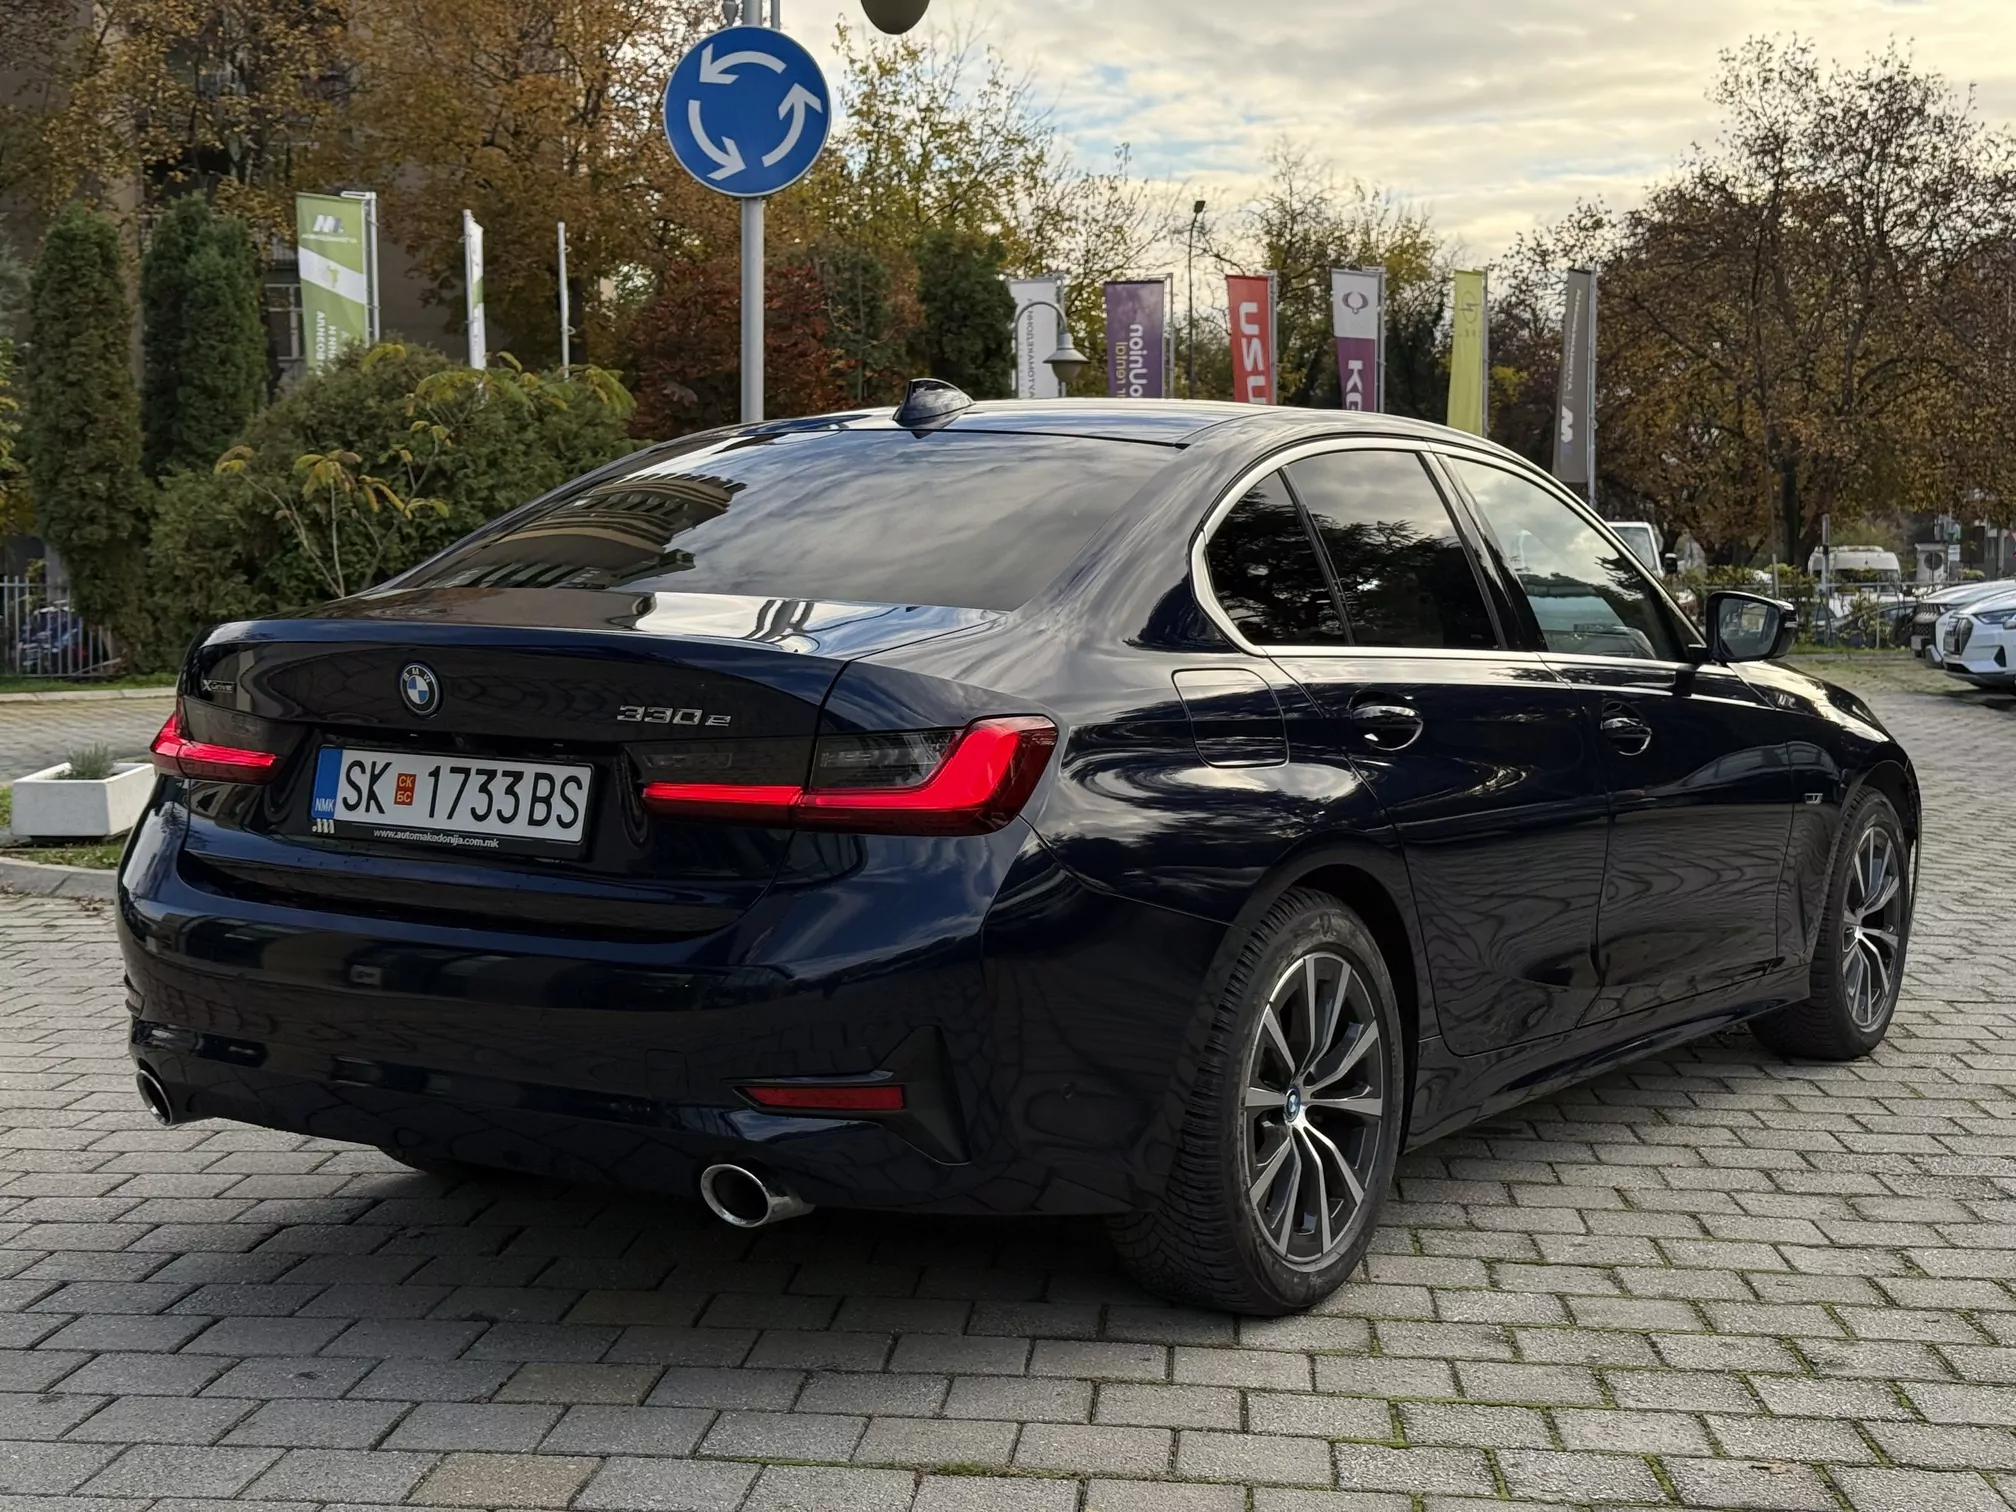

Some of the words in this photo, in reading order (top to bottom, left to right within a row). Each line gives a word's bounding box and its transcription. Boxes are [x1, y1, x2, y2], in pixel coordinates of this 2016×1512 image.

[1345, 360, 1363, 411] KG
[617, 705, 732, 727] 330e
[342, 760, 393, 814] SK
[315, 798, 335, 812] NMK
[373, 828, 499, 848] www.automakedonija.com.mk
